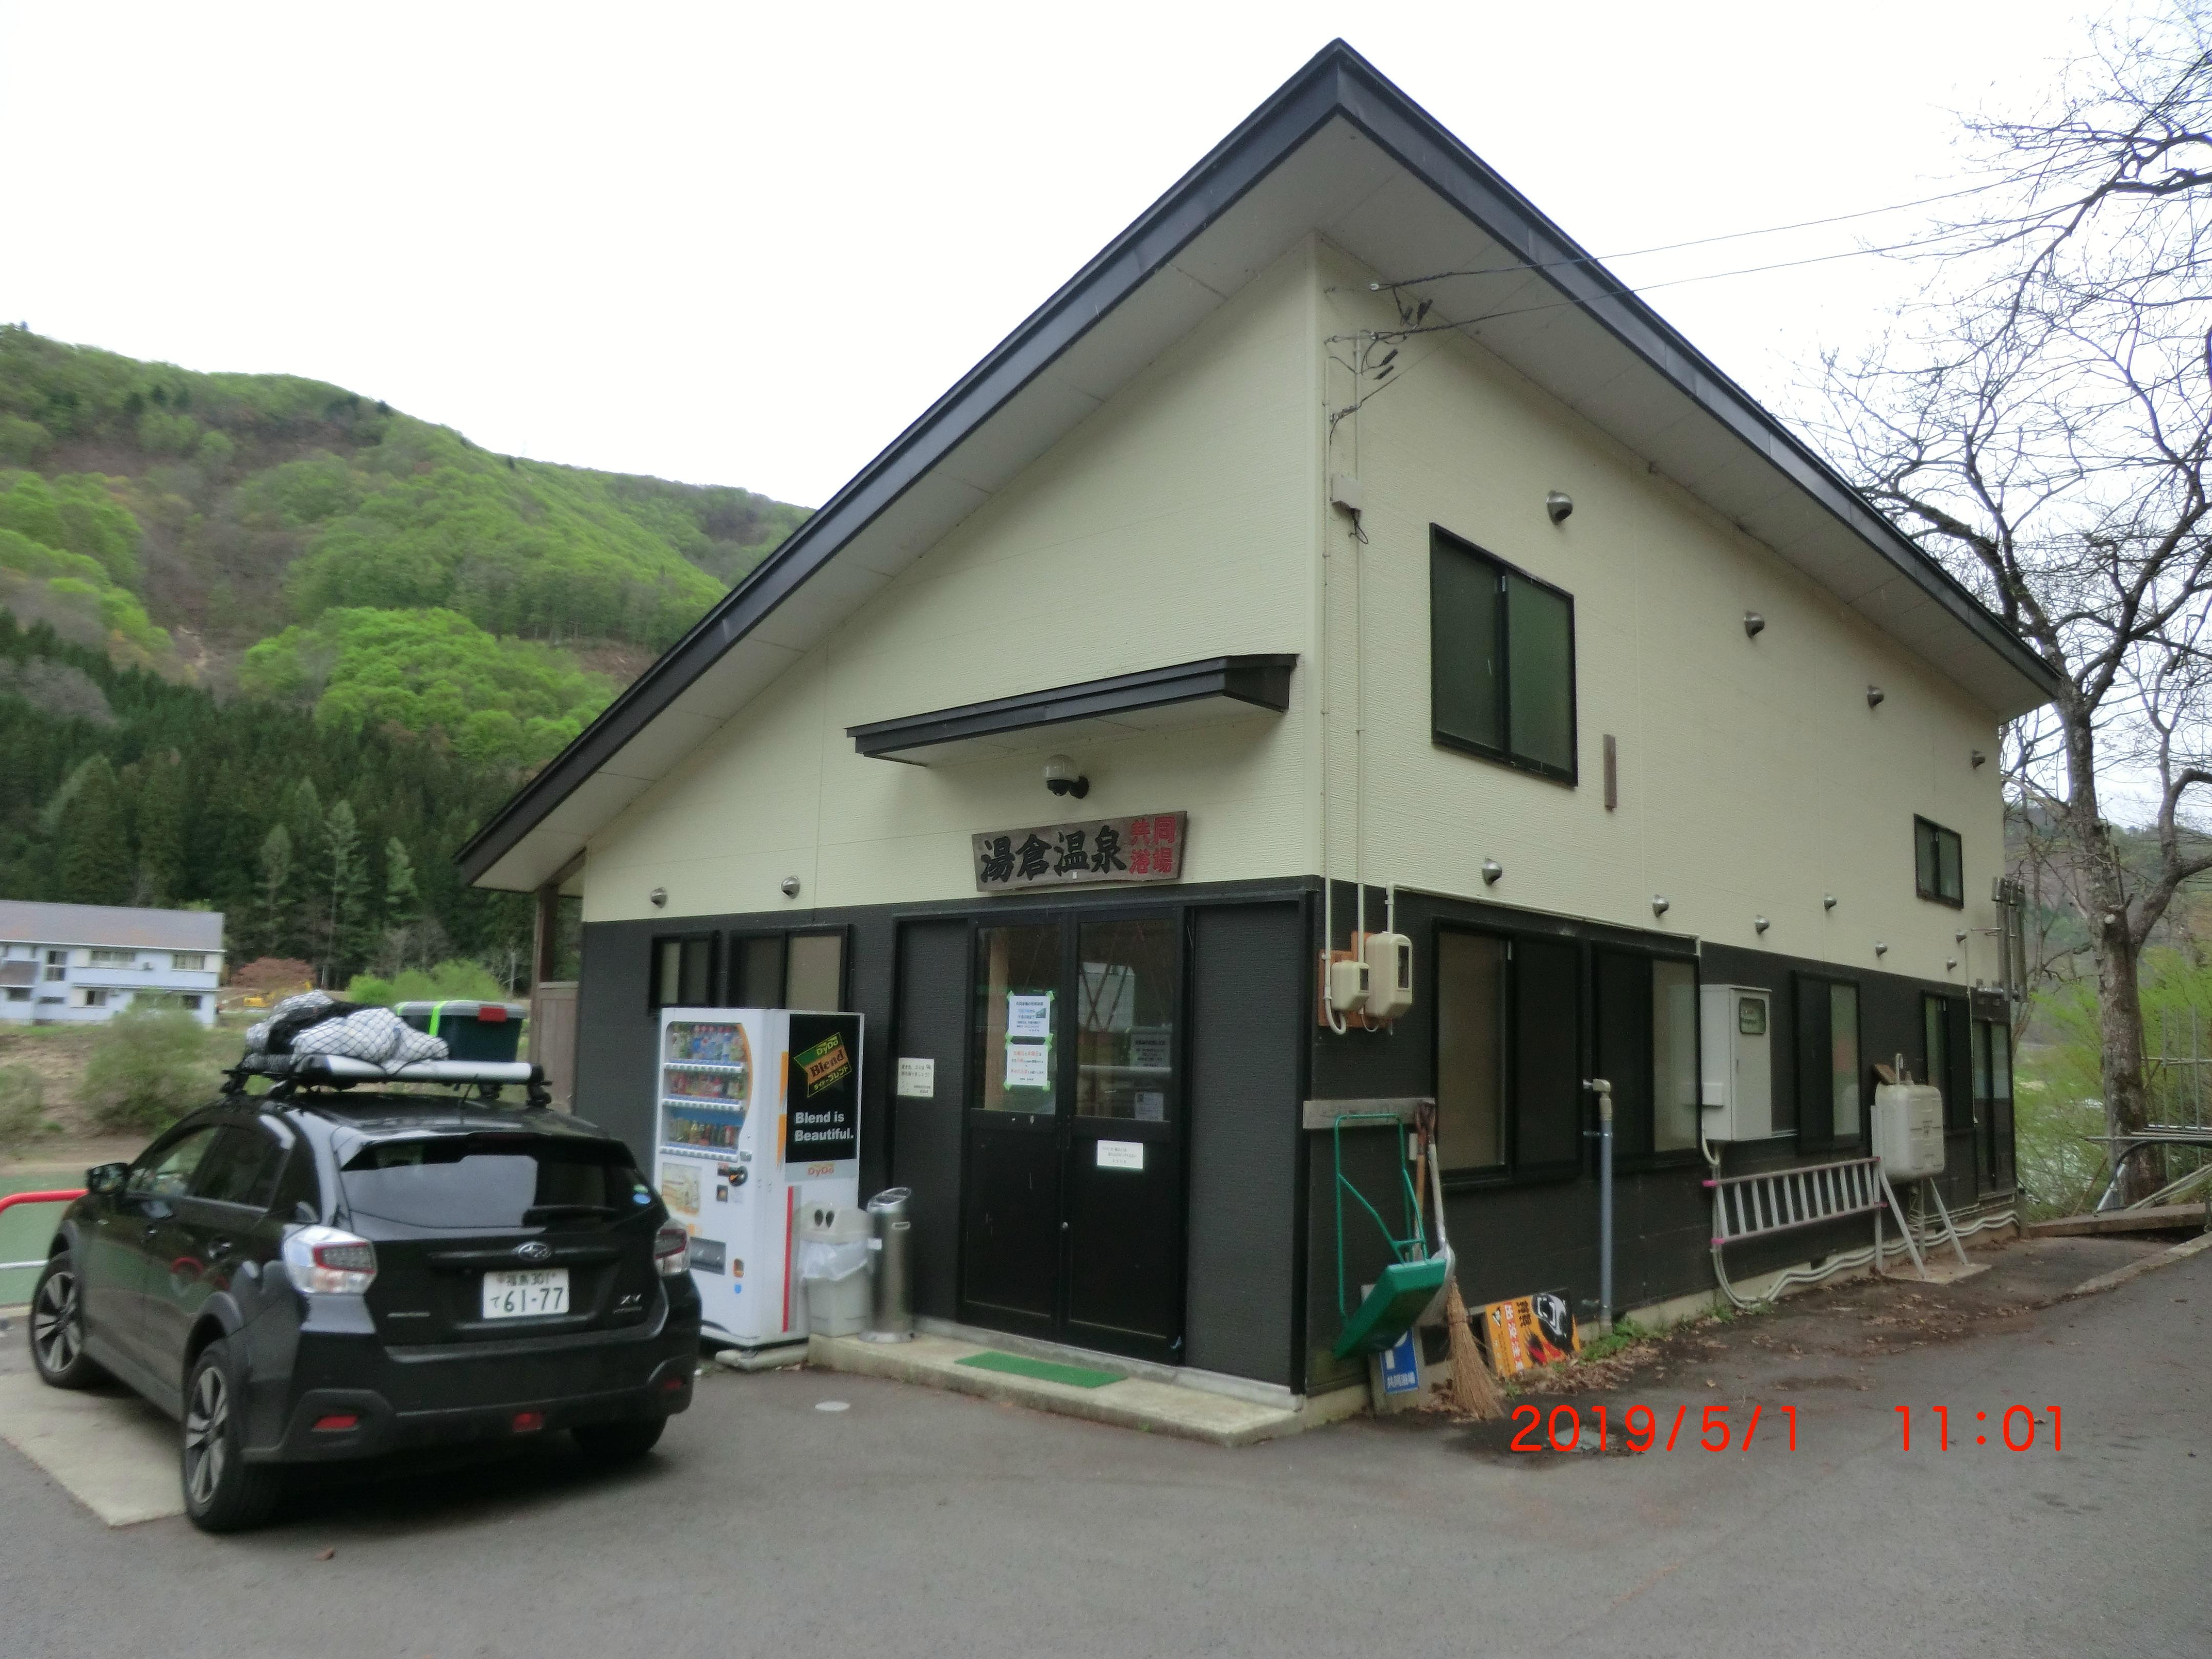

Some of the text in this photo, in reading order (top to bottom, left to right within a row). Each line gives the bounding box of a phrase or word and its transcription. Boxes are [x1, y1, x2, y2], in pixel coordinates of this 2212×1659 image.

[980, 825, 1127, 882] 湯倉温泉
[816, 1040, 839, 1055] DyDo
[810, 1049, 844, 1077] Blend
[795, 1111, 844, 1124] Blend is
[794, 1128, 854, 1142] Beautiful.
[807, 1166, 835, 1178] DyDo
[504, 1287, 563, 1313] 61-77
